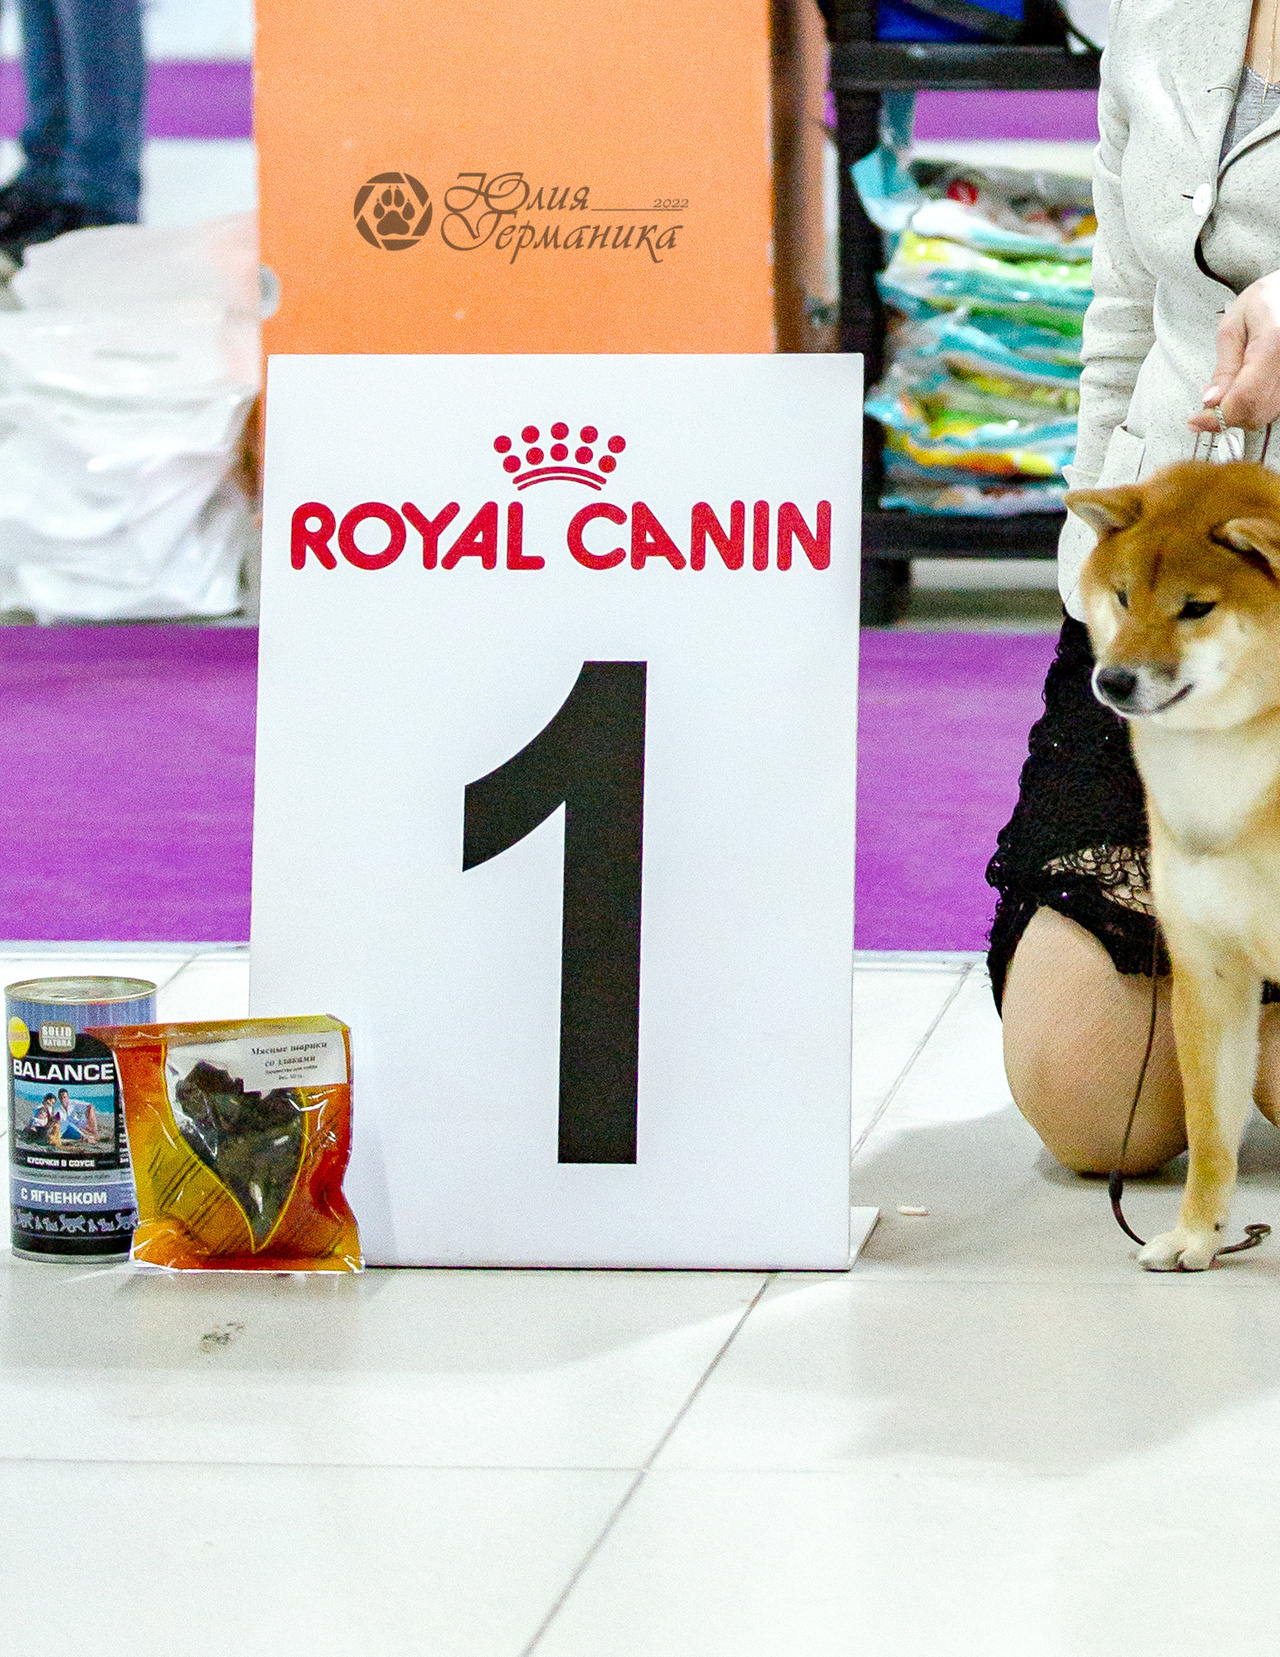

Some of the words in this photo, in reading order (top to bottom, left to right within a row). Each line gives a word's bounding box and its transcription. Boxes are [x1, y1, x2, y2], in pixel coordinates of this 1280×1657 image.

[291, 501, 546, 571] ROYAL
[567, 500, 832, 572] CANIN
[463, 662, 648, 1166] 1
[42, 1025, 72, 1037] SOLID
[13, 1058, 115, 1081] BALANCE
[20, 1187, 29, 1200] С
[30, 1189, 108, 1204] ЯГНЕНКОМ
